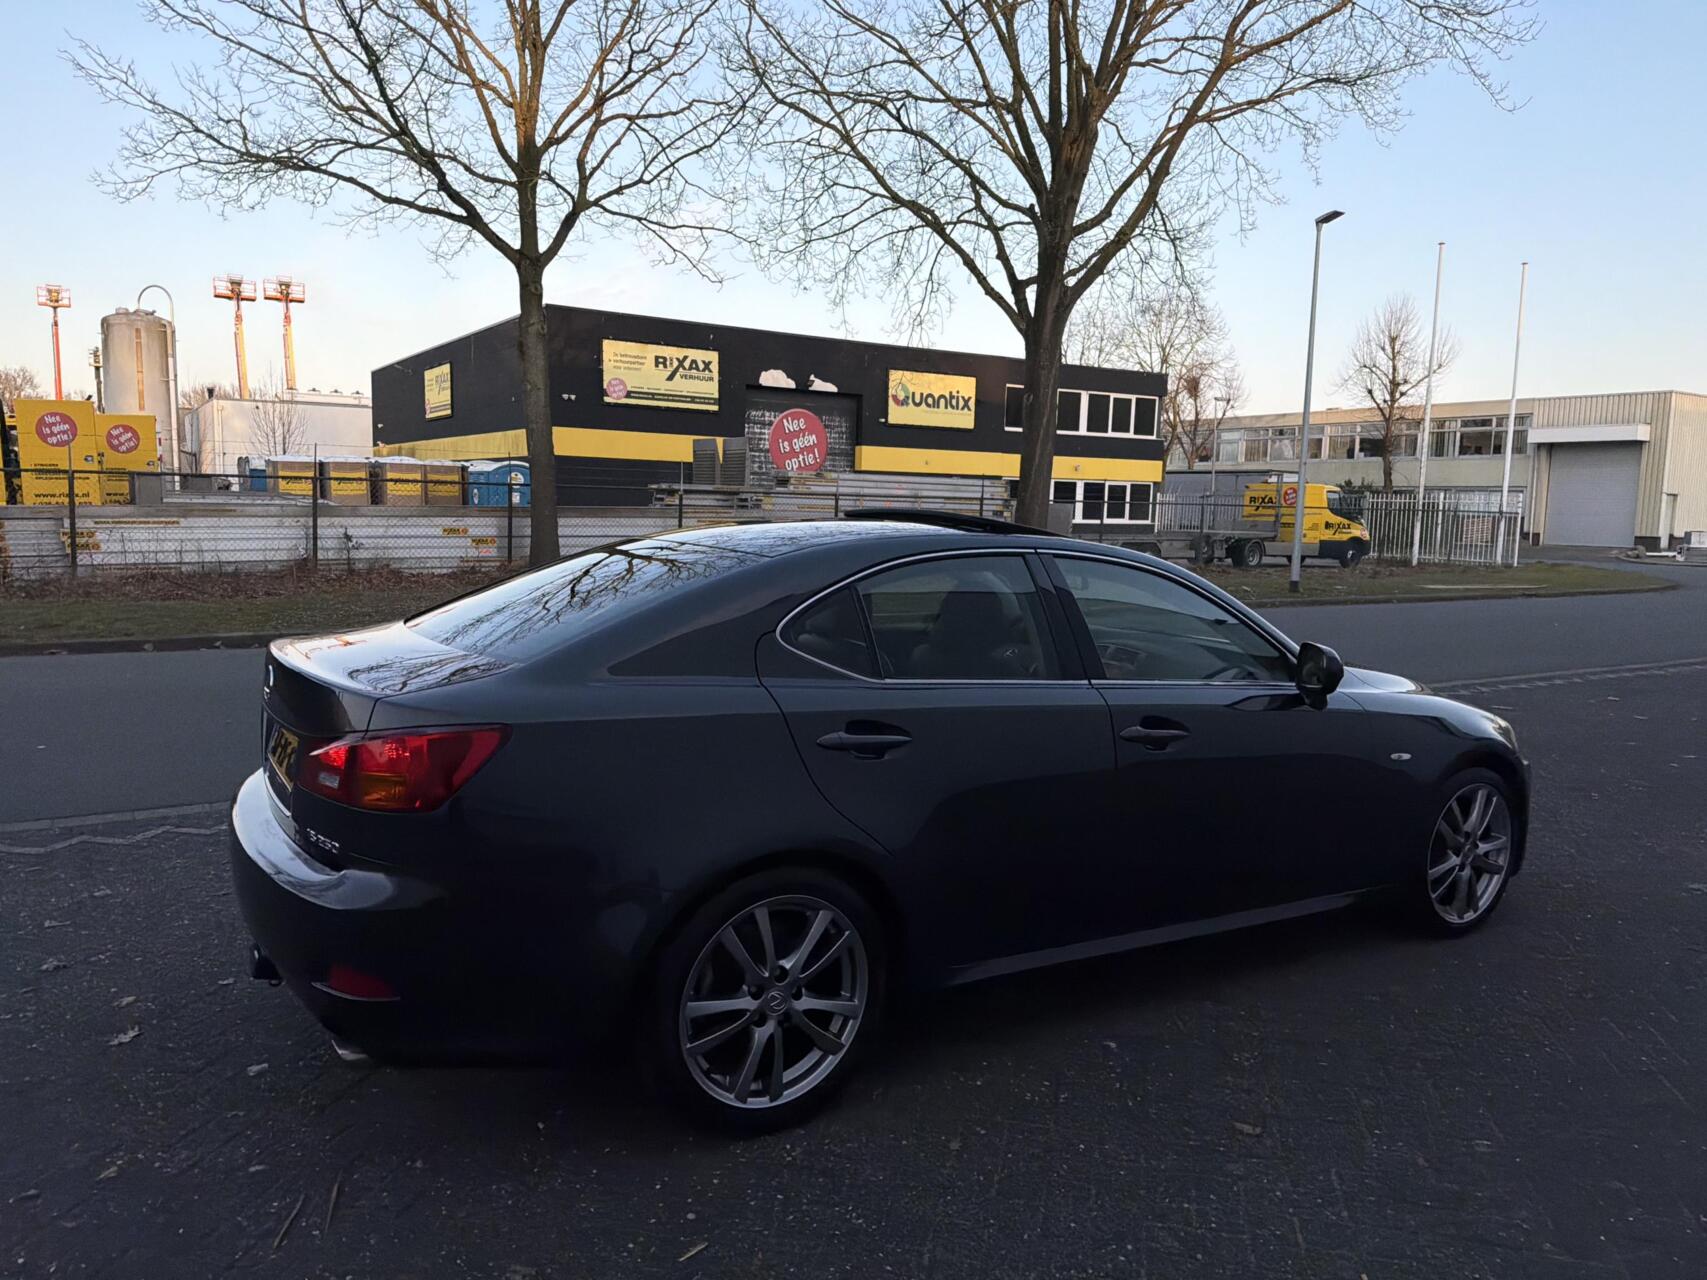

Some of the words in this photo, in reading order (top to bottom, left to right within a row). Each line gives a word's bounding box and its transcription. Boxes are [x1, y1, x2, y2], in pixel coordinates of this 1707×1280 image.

[654, 355, 713, 382] RIXAX
[679, 373, 714, 382] VERHUUR
[44, 414, 61, 424] Nee
[782, 416, 807, 433] Nee
[779, 439, 790, 453] is
[792, 431, 817, 452] géén
[785, 447, 820, 471] optie!
